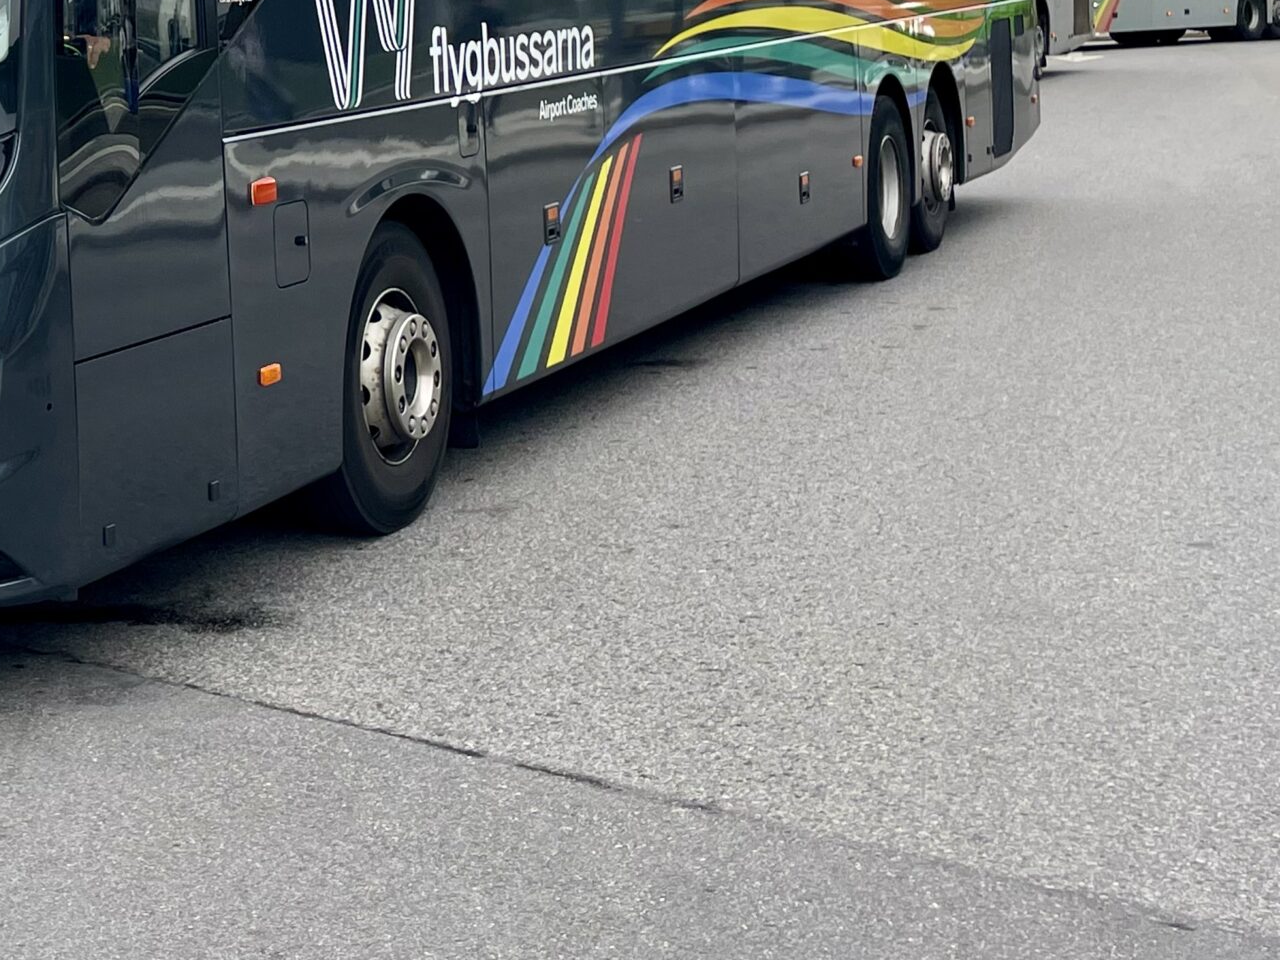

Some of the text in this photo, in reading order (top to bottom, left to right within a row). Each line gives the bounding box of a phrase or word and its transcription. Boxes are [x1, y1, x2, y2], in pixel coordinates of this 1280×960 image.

[429, 22, 595, 107] flygbussarna
[539, 91, 598, 122] Airport Coaches
